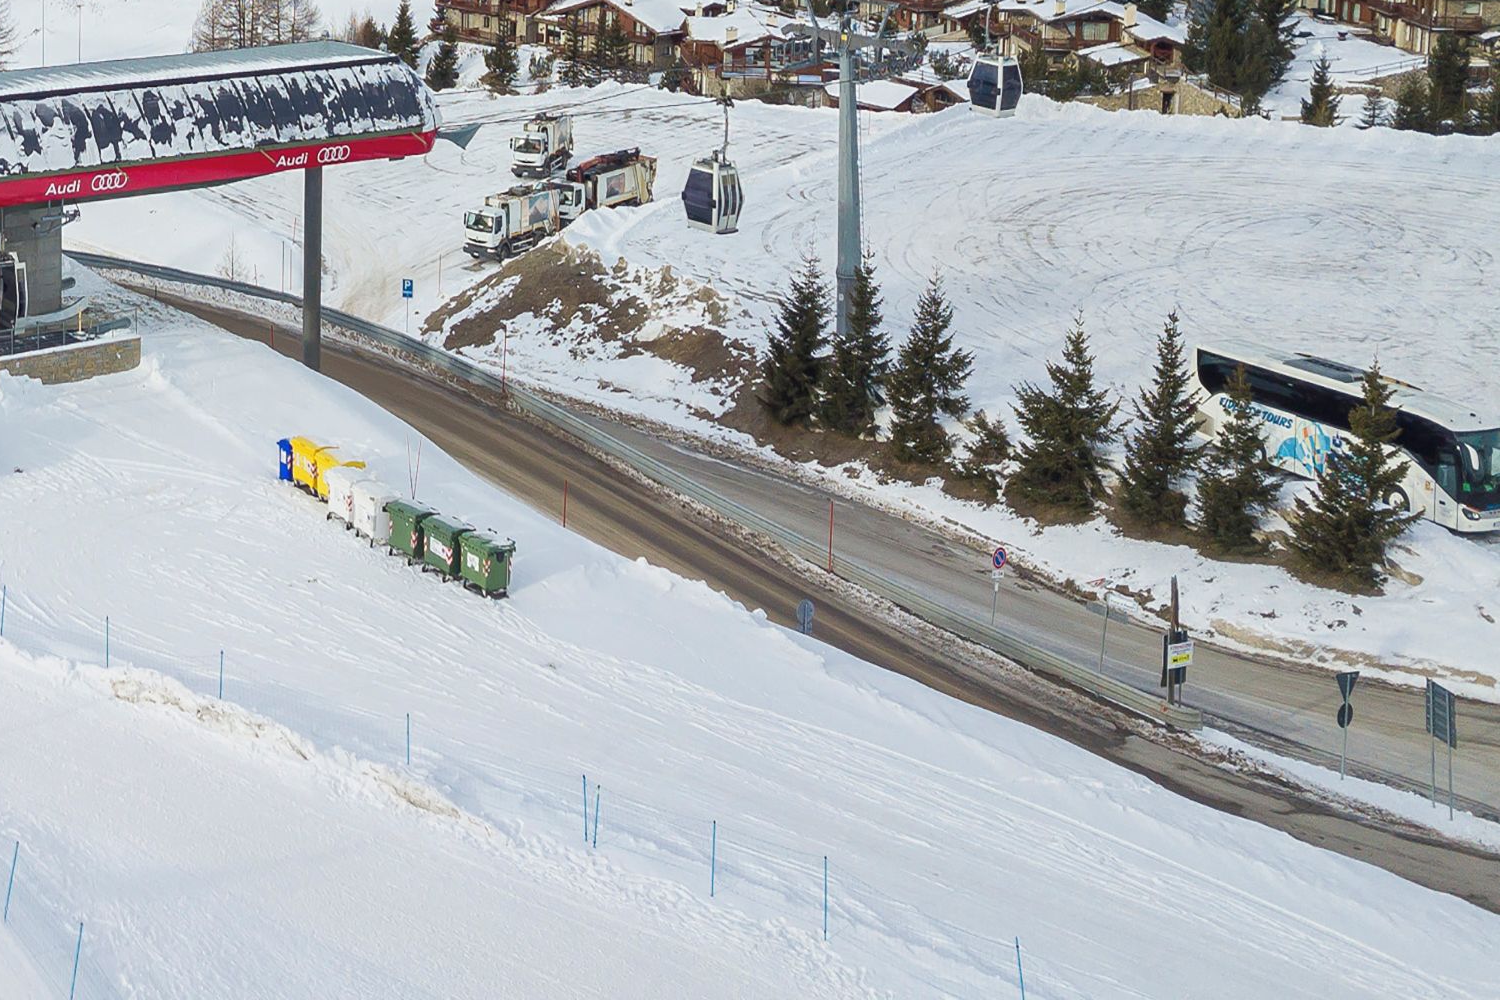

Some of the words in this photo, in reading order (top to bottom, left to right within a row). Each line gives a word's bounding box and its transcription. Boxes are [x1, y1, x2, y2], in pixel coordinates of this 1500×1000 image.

[276, 152, 309, 168] Audi
[45, 179, 81, 196] Audi
[404, 280, 412, 289] P
[1261, 411, 1293, 429] TOURS
